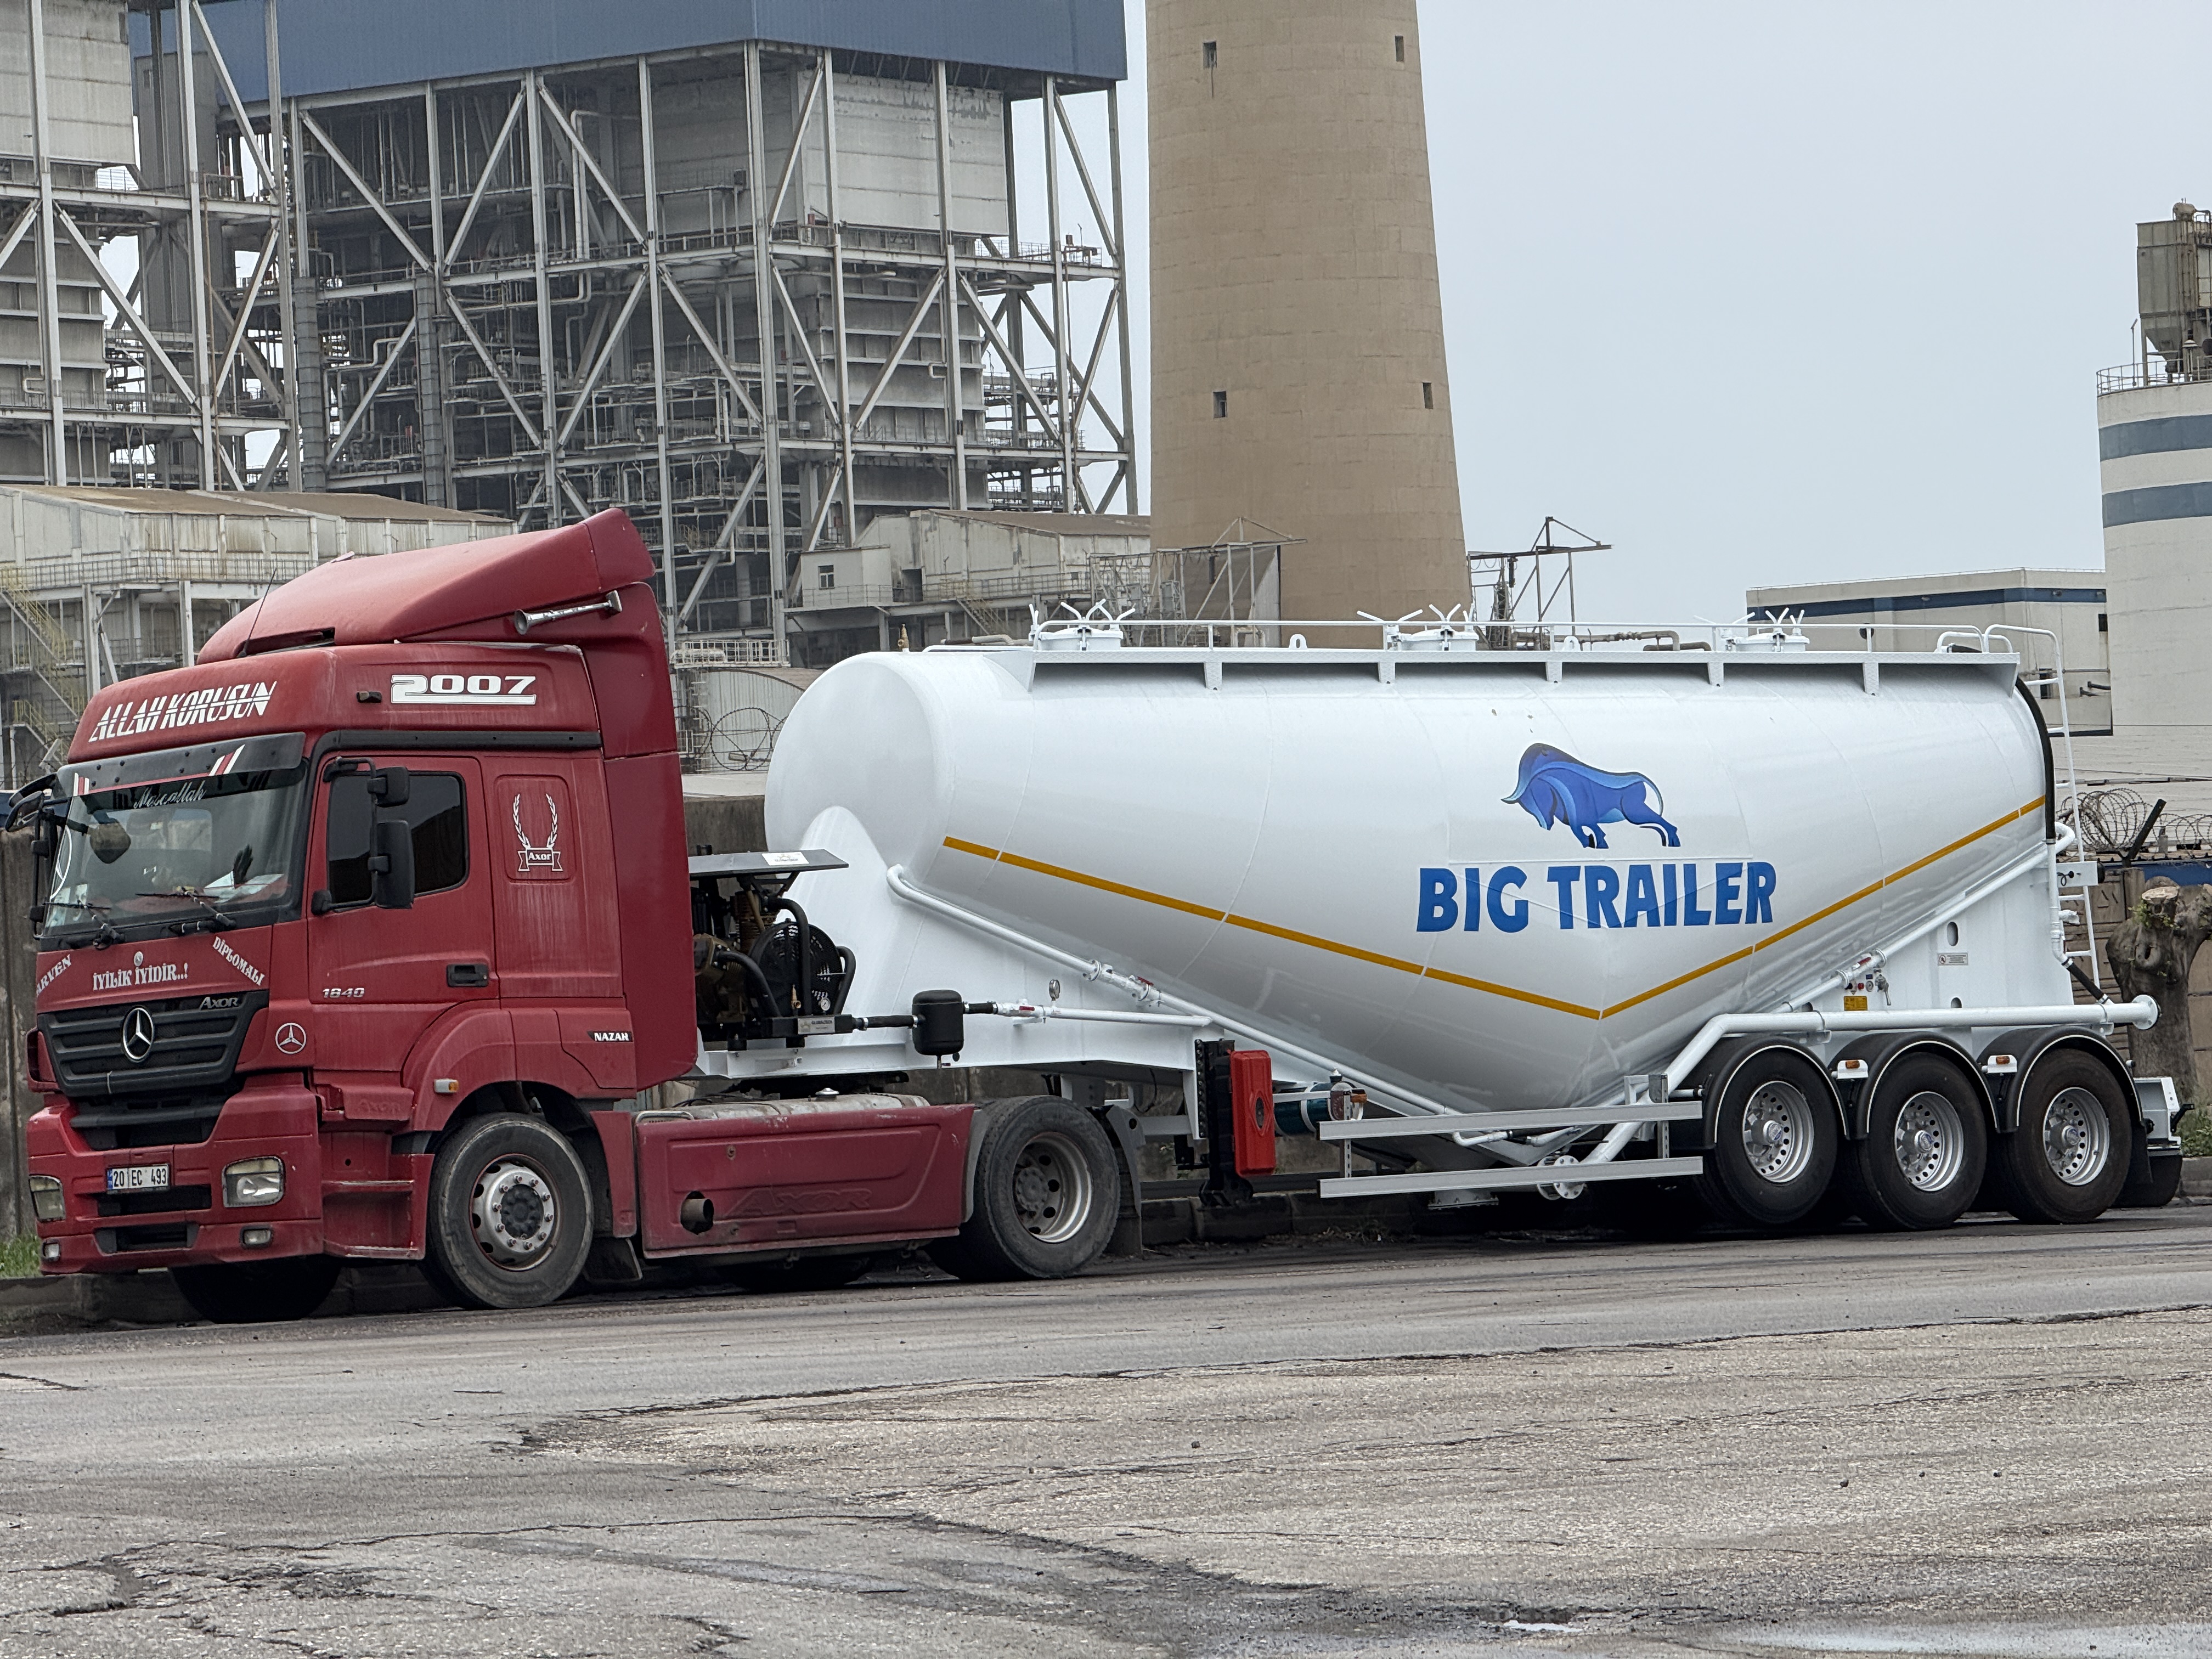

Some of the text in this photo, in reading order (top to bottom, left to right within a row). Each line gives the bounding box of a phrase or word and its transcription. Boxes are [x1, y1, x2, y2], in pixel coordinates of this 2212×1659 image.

[391, 675, 537, 704] 2007
[88, 680, 277, 742] ALLAH KORUSUN
[528, 852, 551, 860] Axor
[1416, 861, 1777, 933] BIG TRAILER
[212, 936, 265, 986] DİPLOMALI
[93, 968, 133, 991] İYİLİK
[323, 988, 365, 998] 1840
[594, 1032, 629, 1041] NAZAR
[114, 1171, 125, 1187] 20
[132, 1169, 142, 1186] EC
[151, 1168, 166, 1185] 493
